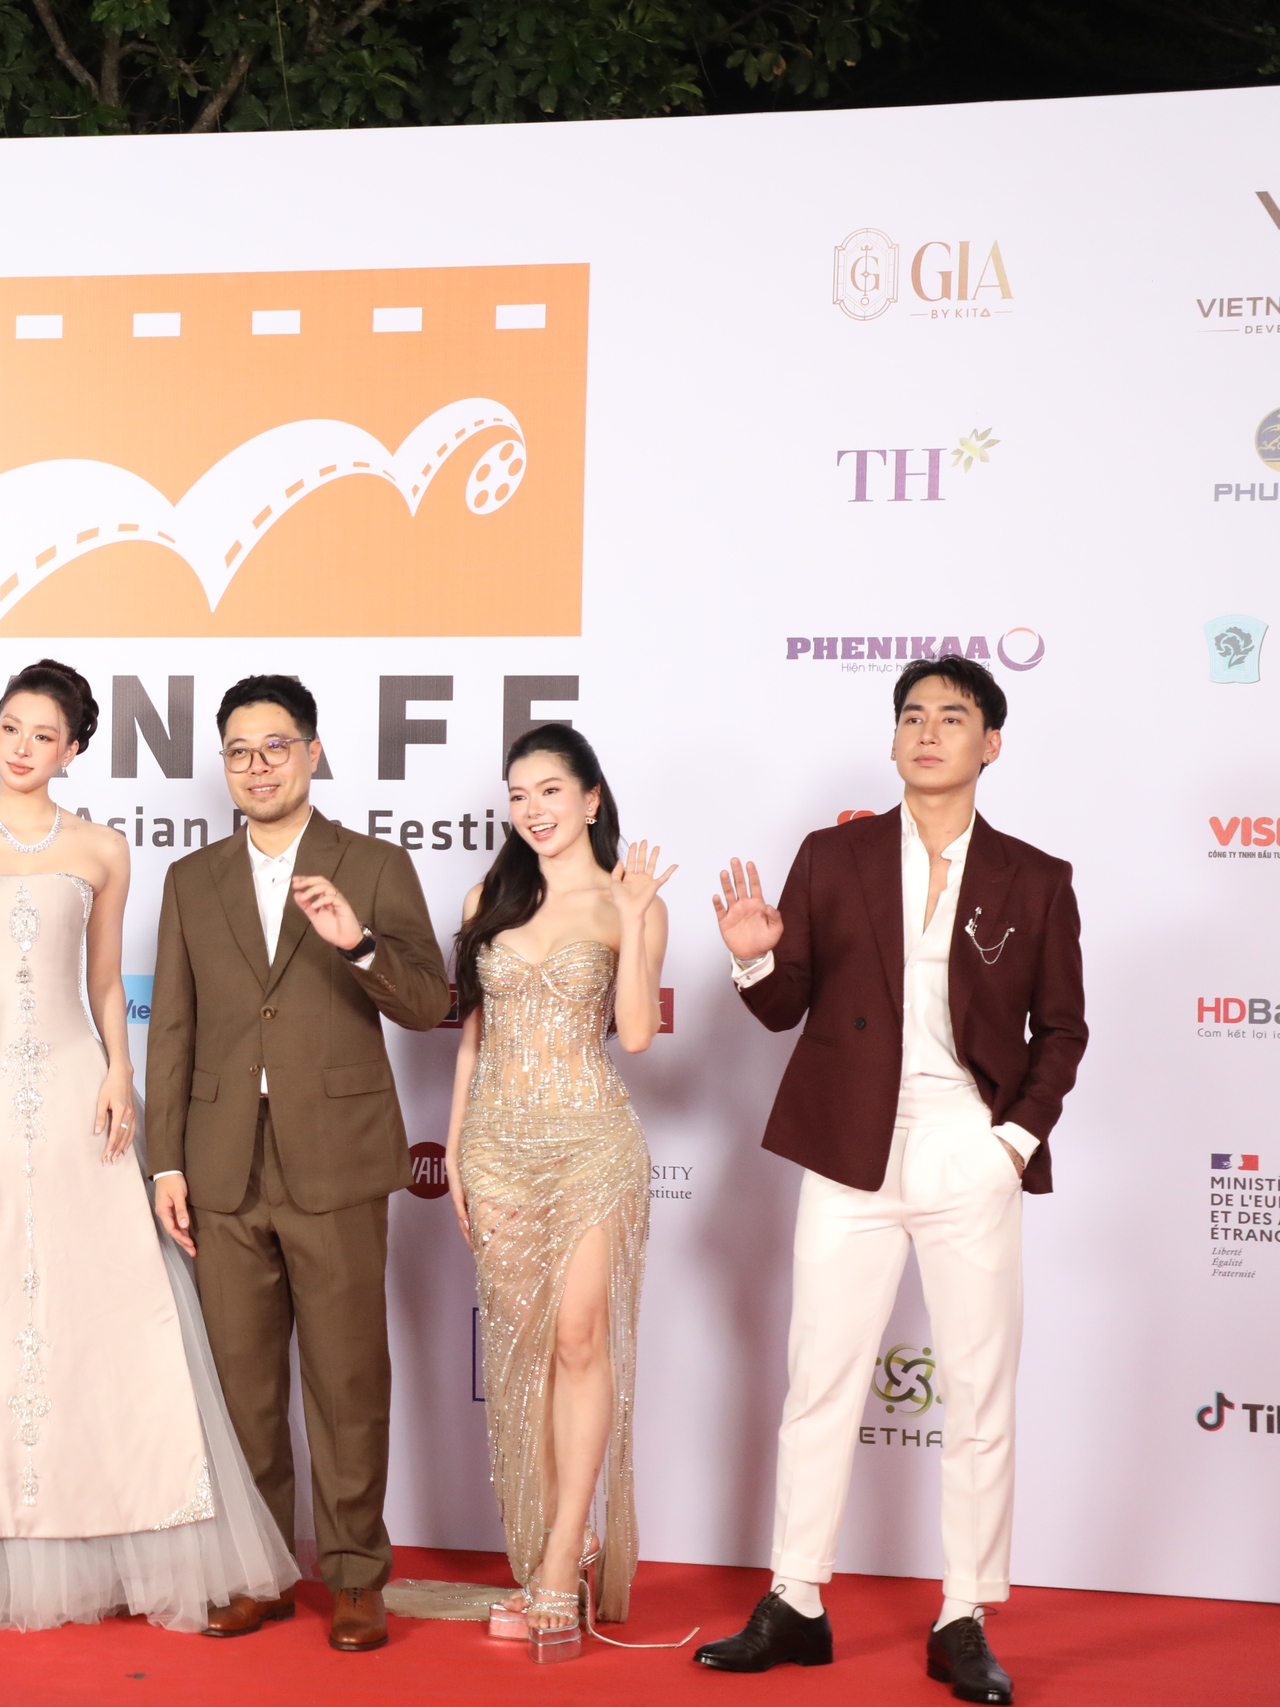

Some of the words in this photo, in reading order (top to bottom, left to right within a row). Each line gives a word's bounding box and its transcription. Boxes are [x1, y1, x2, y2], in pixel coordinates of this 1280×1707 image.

[910, 239, 1015, 302] GIA
[931, 309, 950, 319] BY
[837, 448, 947, 502] TH
[786, 636, 991, 660] PHENIKAA
[841, 662, 866, 674] Hiện
[1197, 1028, 1221, 1037] Cam
[1211, 1193, 1234, 1206] DE
[1241, 1194, 1280, 1209] L'EU
[1211, 1210, 1232, 1223] ET
[1238, 1211, 1272, 1226] DES
[1212, 1248, 1242, 1256] Liberté
[1212, 1269, 1256, 1279] Fraternité
